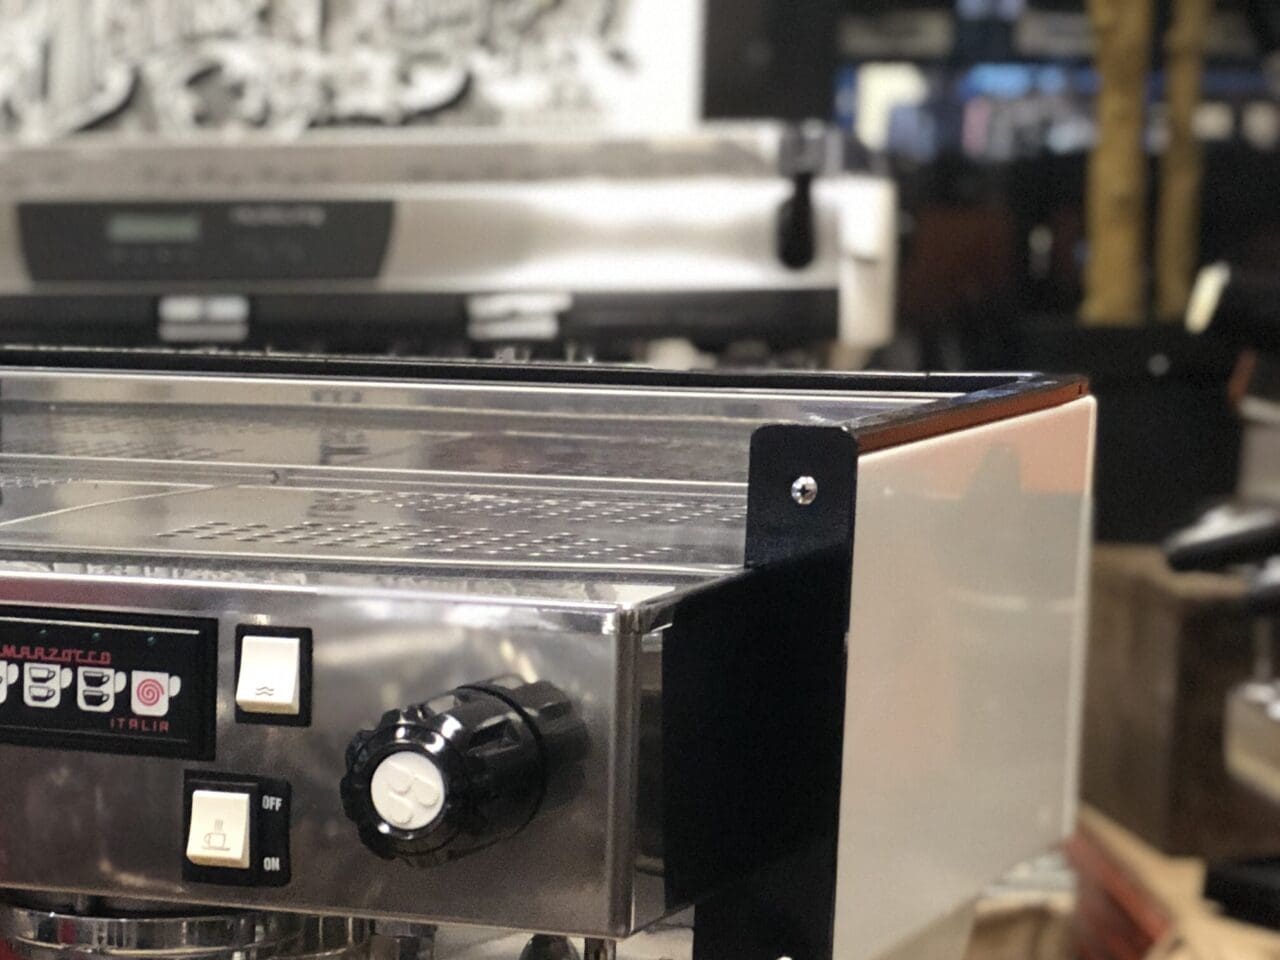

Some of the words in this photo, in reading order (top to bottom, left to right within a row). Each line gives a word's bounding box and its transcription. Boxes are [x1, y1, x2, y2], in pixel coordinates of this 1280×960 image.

[110, 718, 170, 732] ITALIA
[261, 794, 283, 811] OFF
[263, 856, 280, 871] ON
